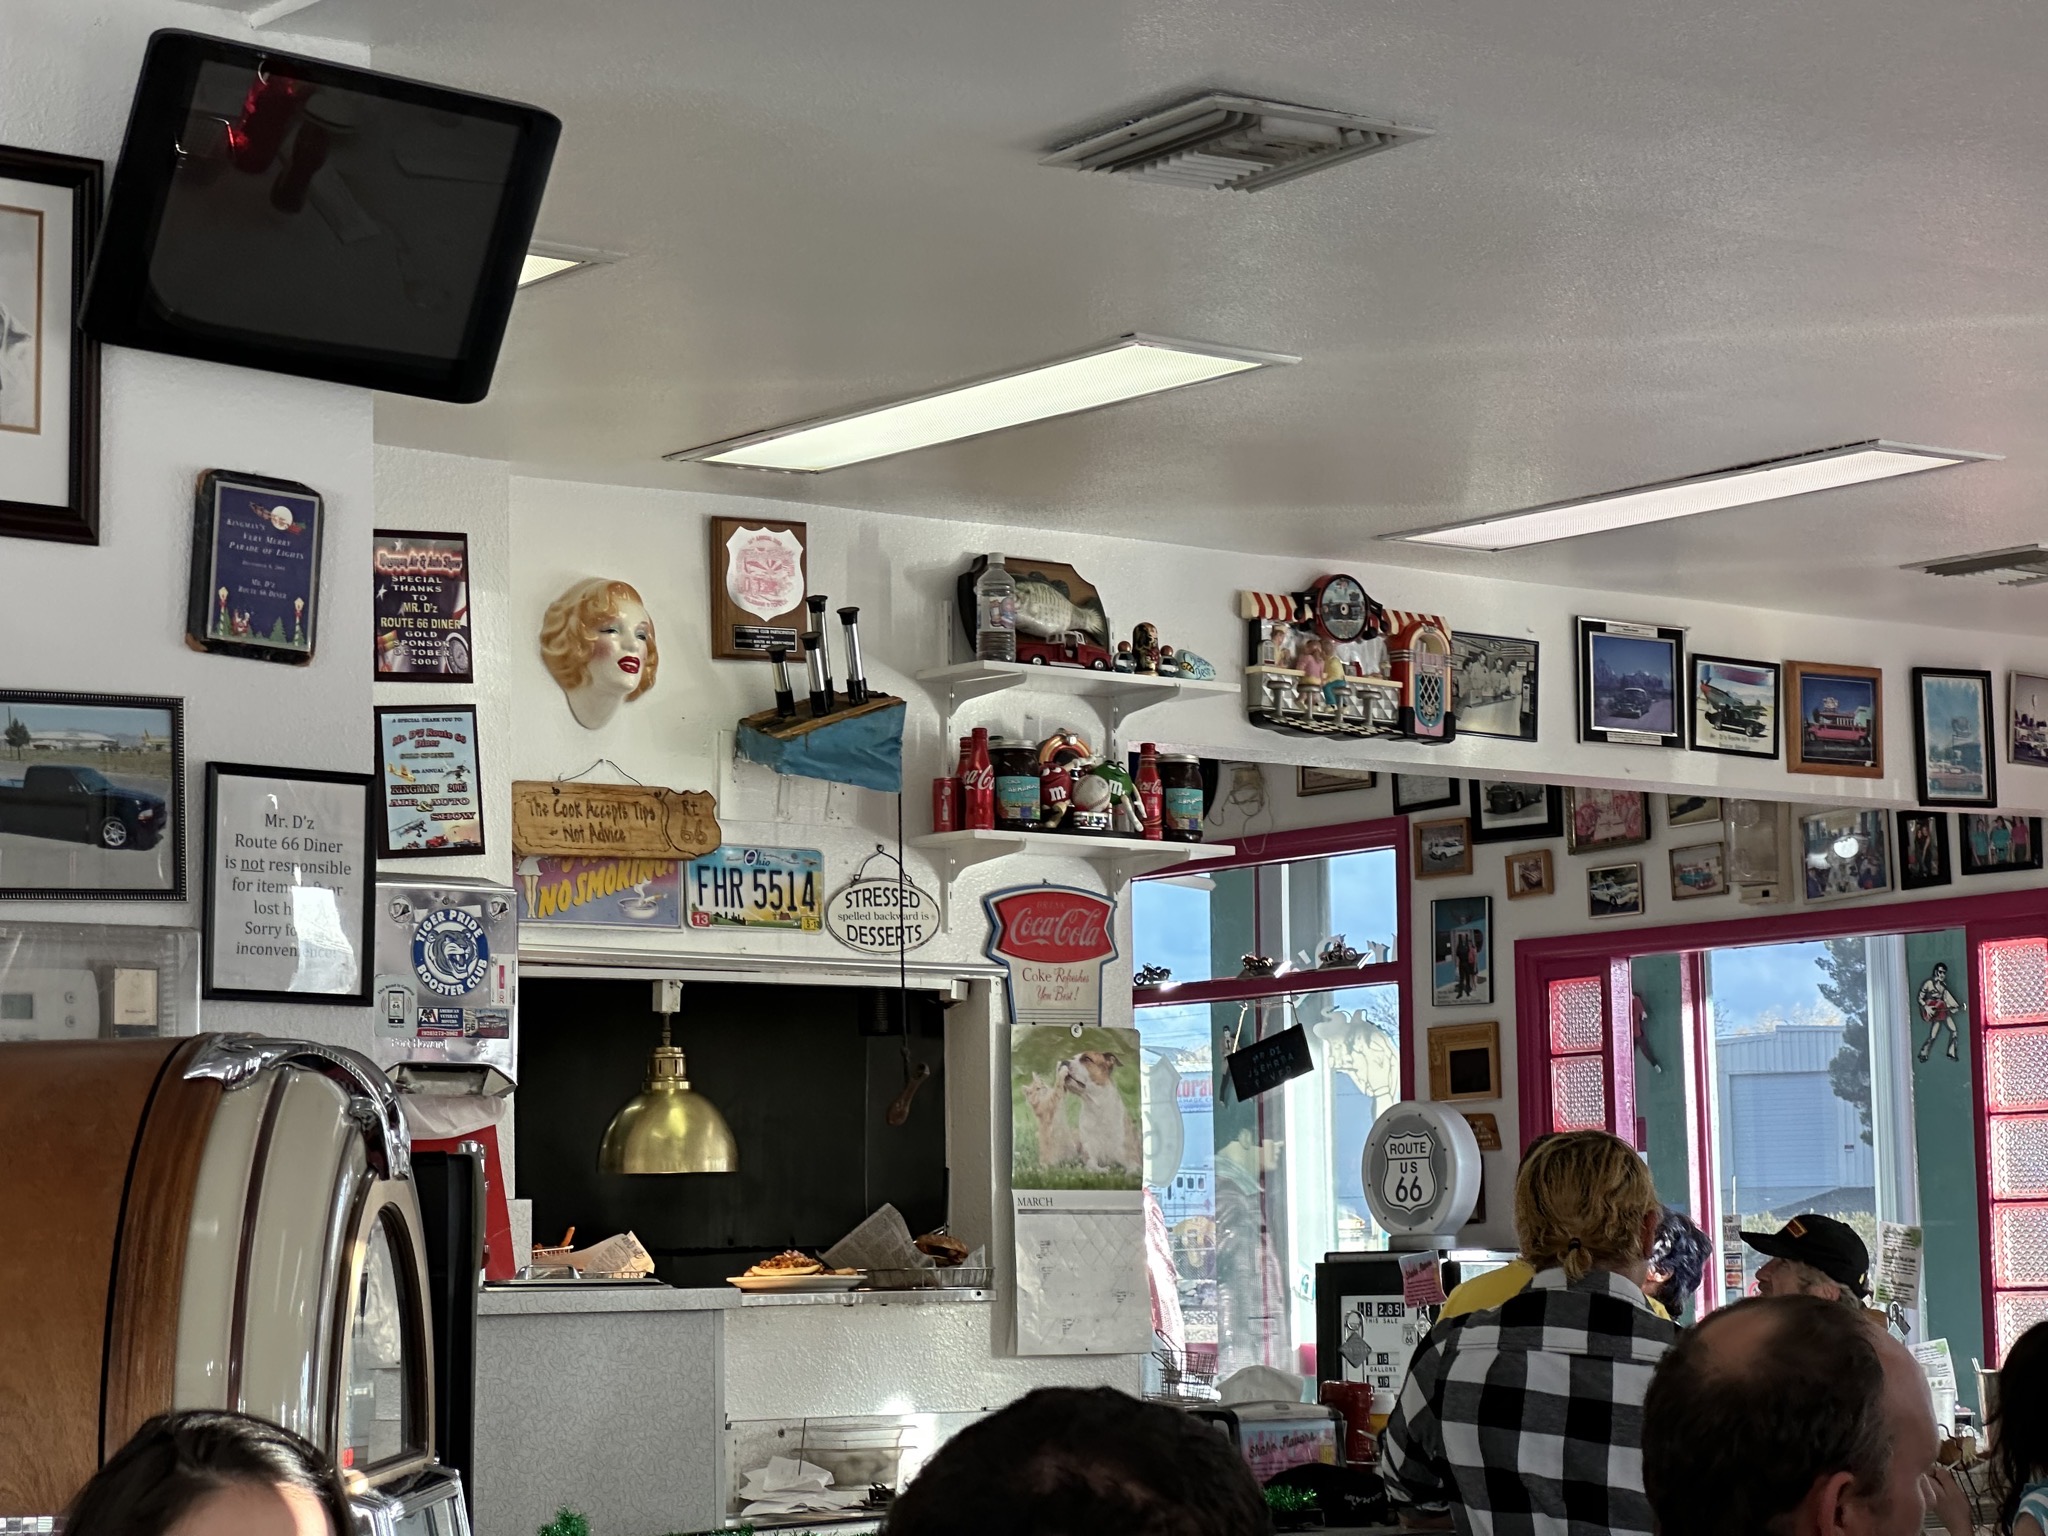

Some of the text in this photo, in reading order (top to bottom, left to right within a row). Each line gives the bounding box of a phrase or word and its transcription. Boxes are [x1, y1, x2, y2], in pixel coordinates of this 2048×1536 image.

[266, 536, 291, 547] MERRY
[229, 541, 259, 553] PARADE
[276, 549, 304, 560] LIGHTS
[268, 590, 287, 599] DINER
[393, 585, 442, 593] THANKS
[404, 602, 421, 613] MR.
[381, 617, 461, 630] ROUTE 66 DINER
[393, 640, 450, 648] SPONSOR
[394, 649, 450, 657] OCTOBER
[411, 658, 439, 666] 2006
[391, 784, 439, 795] KINGMAN
[1049, 786, 1066, 801] m
[1109, 780, 1123, 796] m
[430, 812, 476, 821] SHOW
[530, 799, 656, 827] The Cook Accepts Tips
[681, 799, 700, 817] Rt
[265, 813, 315, 830] Mr. D'z
[562, 822, 626, 843] Not Advice
[680, 819, 709, 845] 66
[235, 834, 343, 853] Route 66 Diner
[225, 855, 352, 876] is not responsible
[745, 850, 771, 868] Ohio
[232, 877, 253, 892] for
[697, 865, 816, 912] FHR 5514
[538, 878, 574, 919] NO
[845, 886, 920, 909] STRESSED
[254, 900, 279, 915] lost
[449, 909, 483, 938] PRIDE
[694, 914, 708, 925] 13
[837, 911, 930, 922] spelled backward is
[245, 922, 281, 939] Sorry
[415, 911, 446, 942] TIGER
[847, 925, 922, 946] DESSERTS
[417, 964, 465, 996] BOOSTER
[466, 959, 488, 989] CLUB
[1022, 967, 1090, 988] Coke Refreshes
[1036, 985, 1052, 1004] You
[1390, 1142, 1426, 1155] ROUTE
[1396, 1176, 1422, 1202] 66
[1017, 1197, 1053, 1207] MARCH
[1378, 1304, 1400, 1315] 2.85
[1280, 1432, 1317, 1450] Flavors
